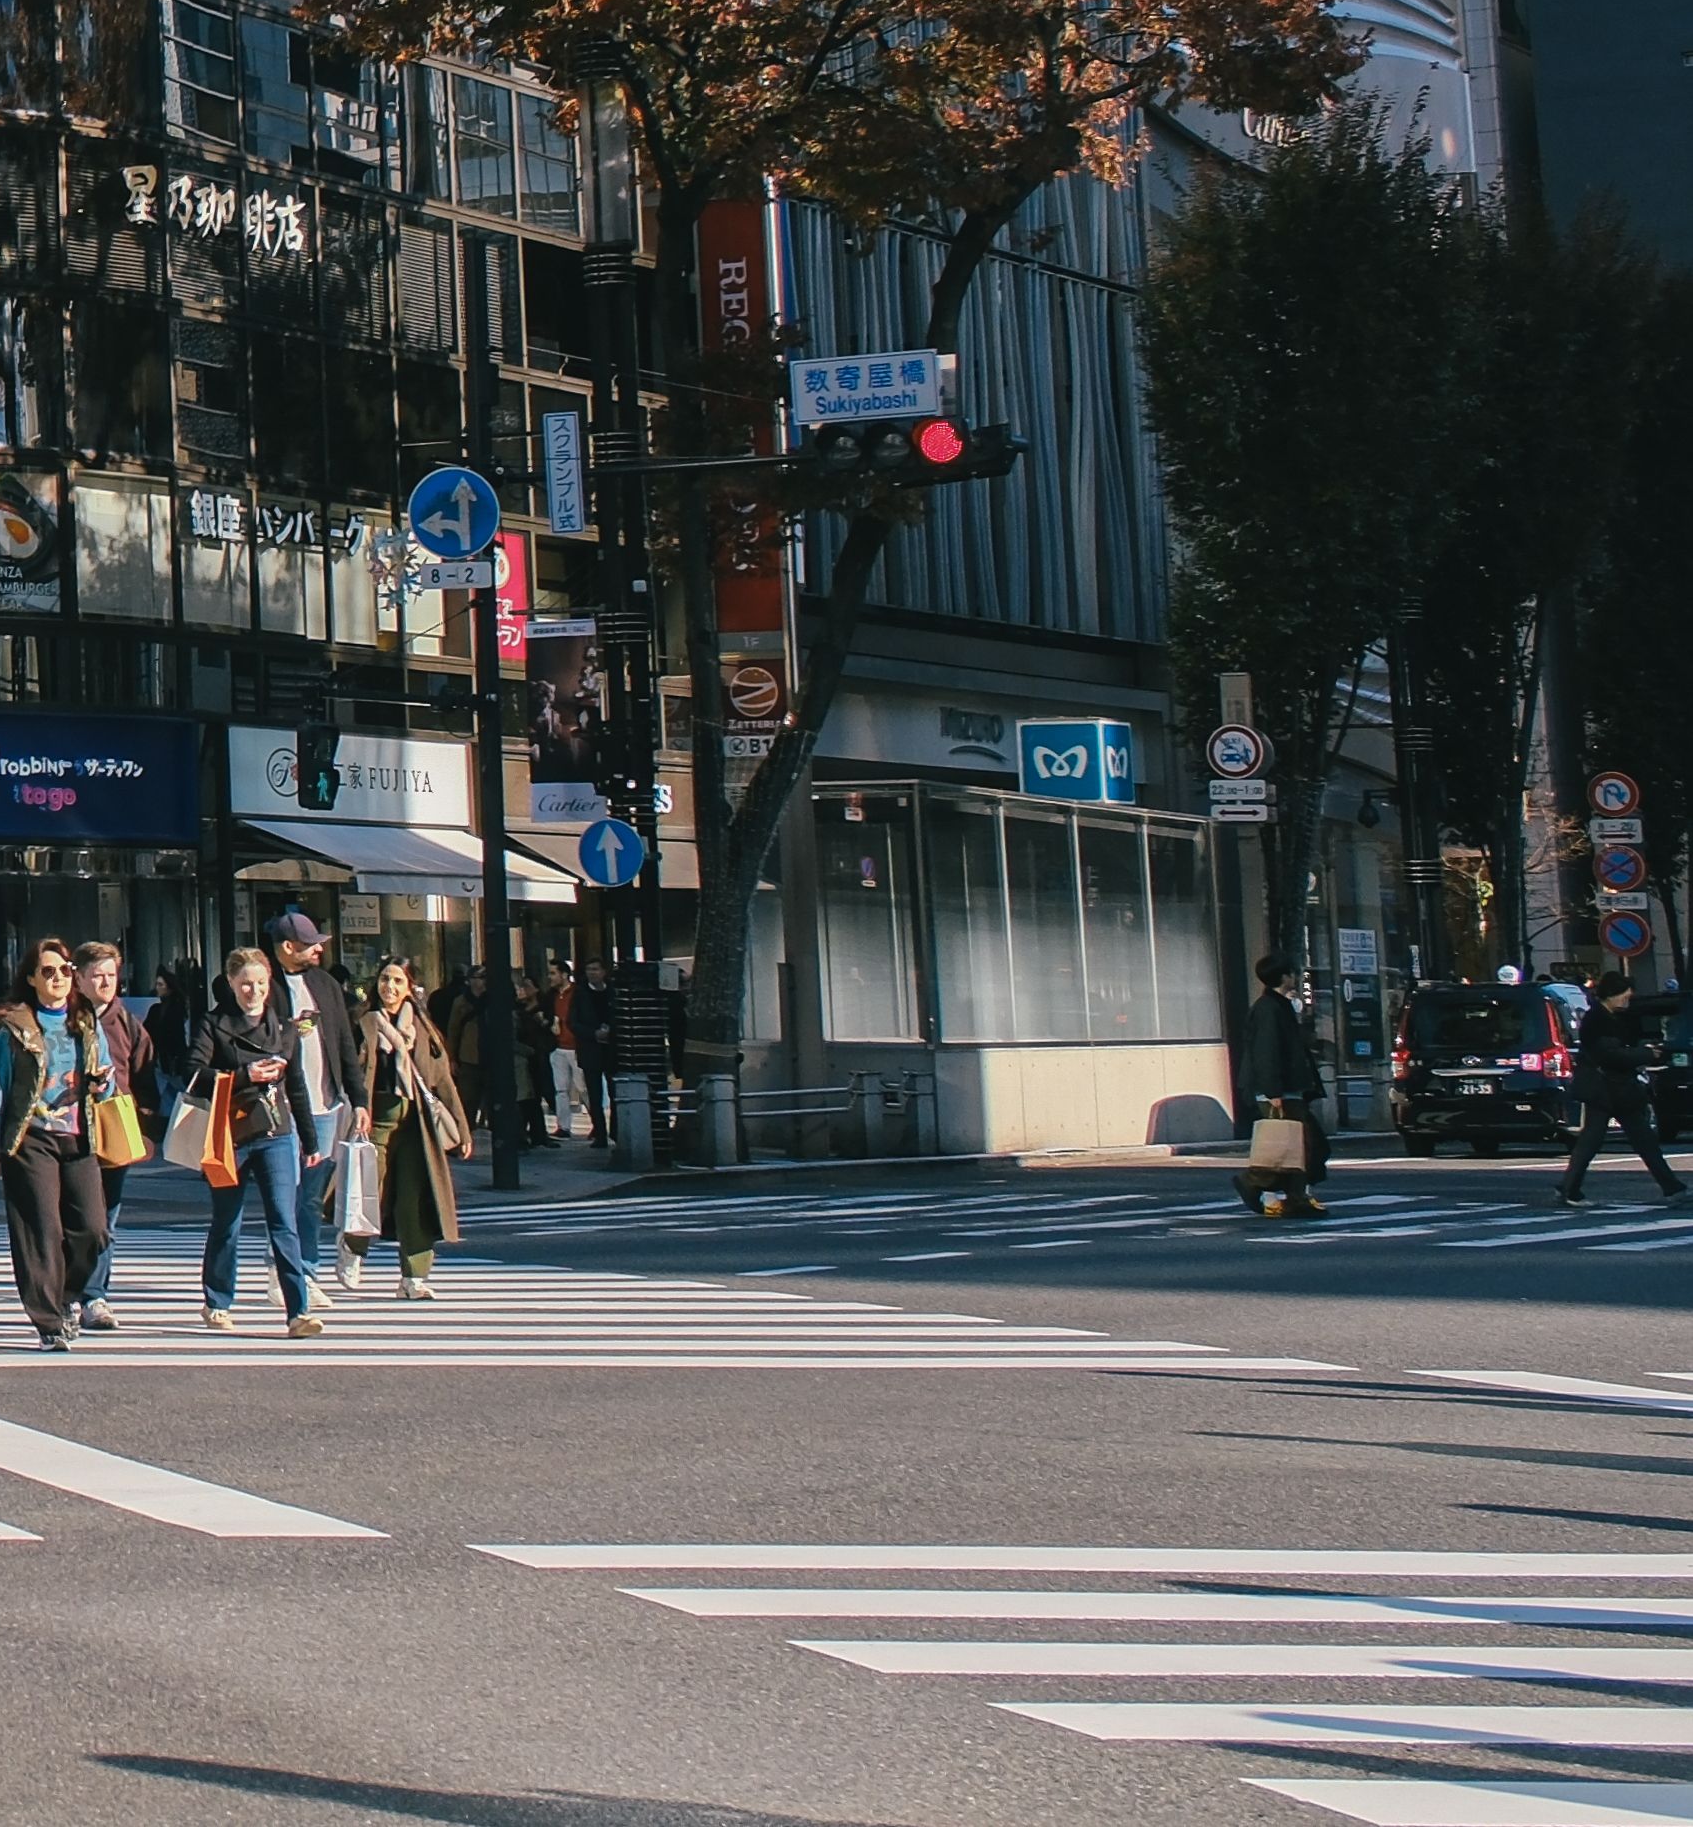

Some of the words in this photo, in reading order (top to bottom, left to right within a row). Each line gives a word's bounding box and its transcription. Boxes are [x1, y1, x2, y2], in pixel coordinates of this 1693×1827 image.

[122, 164, 307, 259] 星乃珈琲店
[803, 359, 926, 395] 数寄屋橋
[815, 389, 918, 416] Sukiyabashi
[552, 419, 580, 533] スクランブル式
[369, 767, 434, 794] FUJIYA
[538, 793, 601, 813] Cartier
